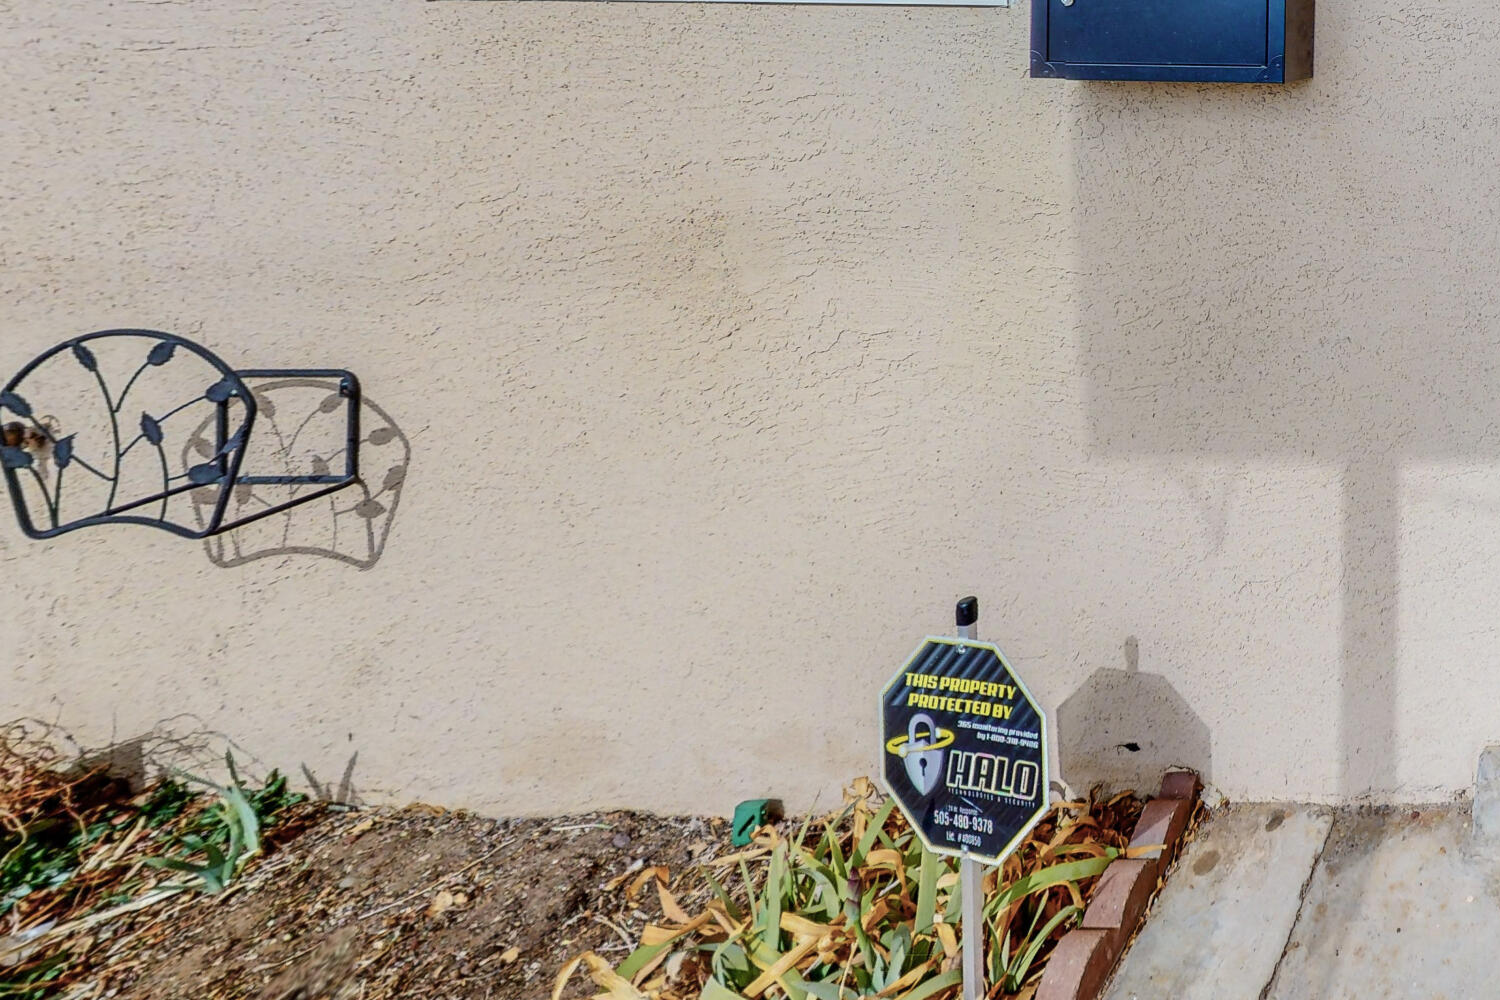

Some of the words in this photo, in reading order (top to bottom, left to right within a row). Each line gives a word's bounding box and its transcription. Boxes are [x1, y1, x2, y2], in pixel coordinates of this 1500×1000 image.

[905, 672, 938, 689] THIS
[939, 676, 1017, 700] PROPERTY
[907, 693, 992, 716] PROTECTED
[992, 704, 1013, 720] BY
[946, 750, 1039, 801] HALO
[934, 809, 993, 835] 505-480-9378
